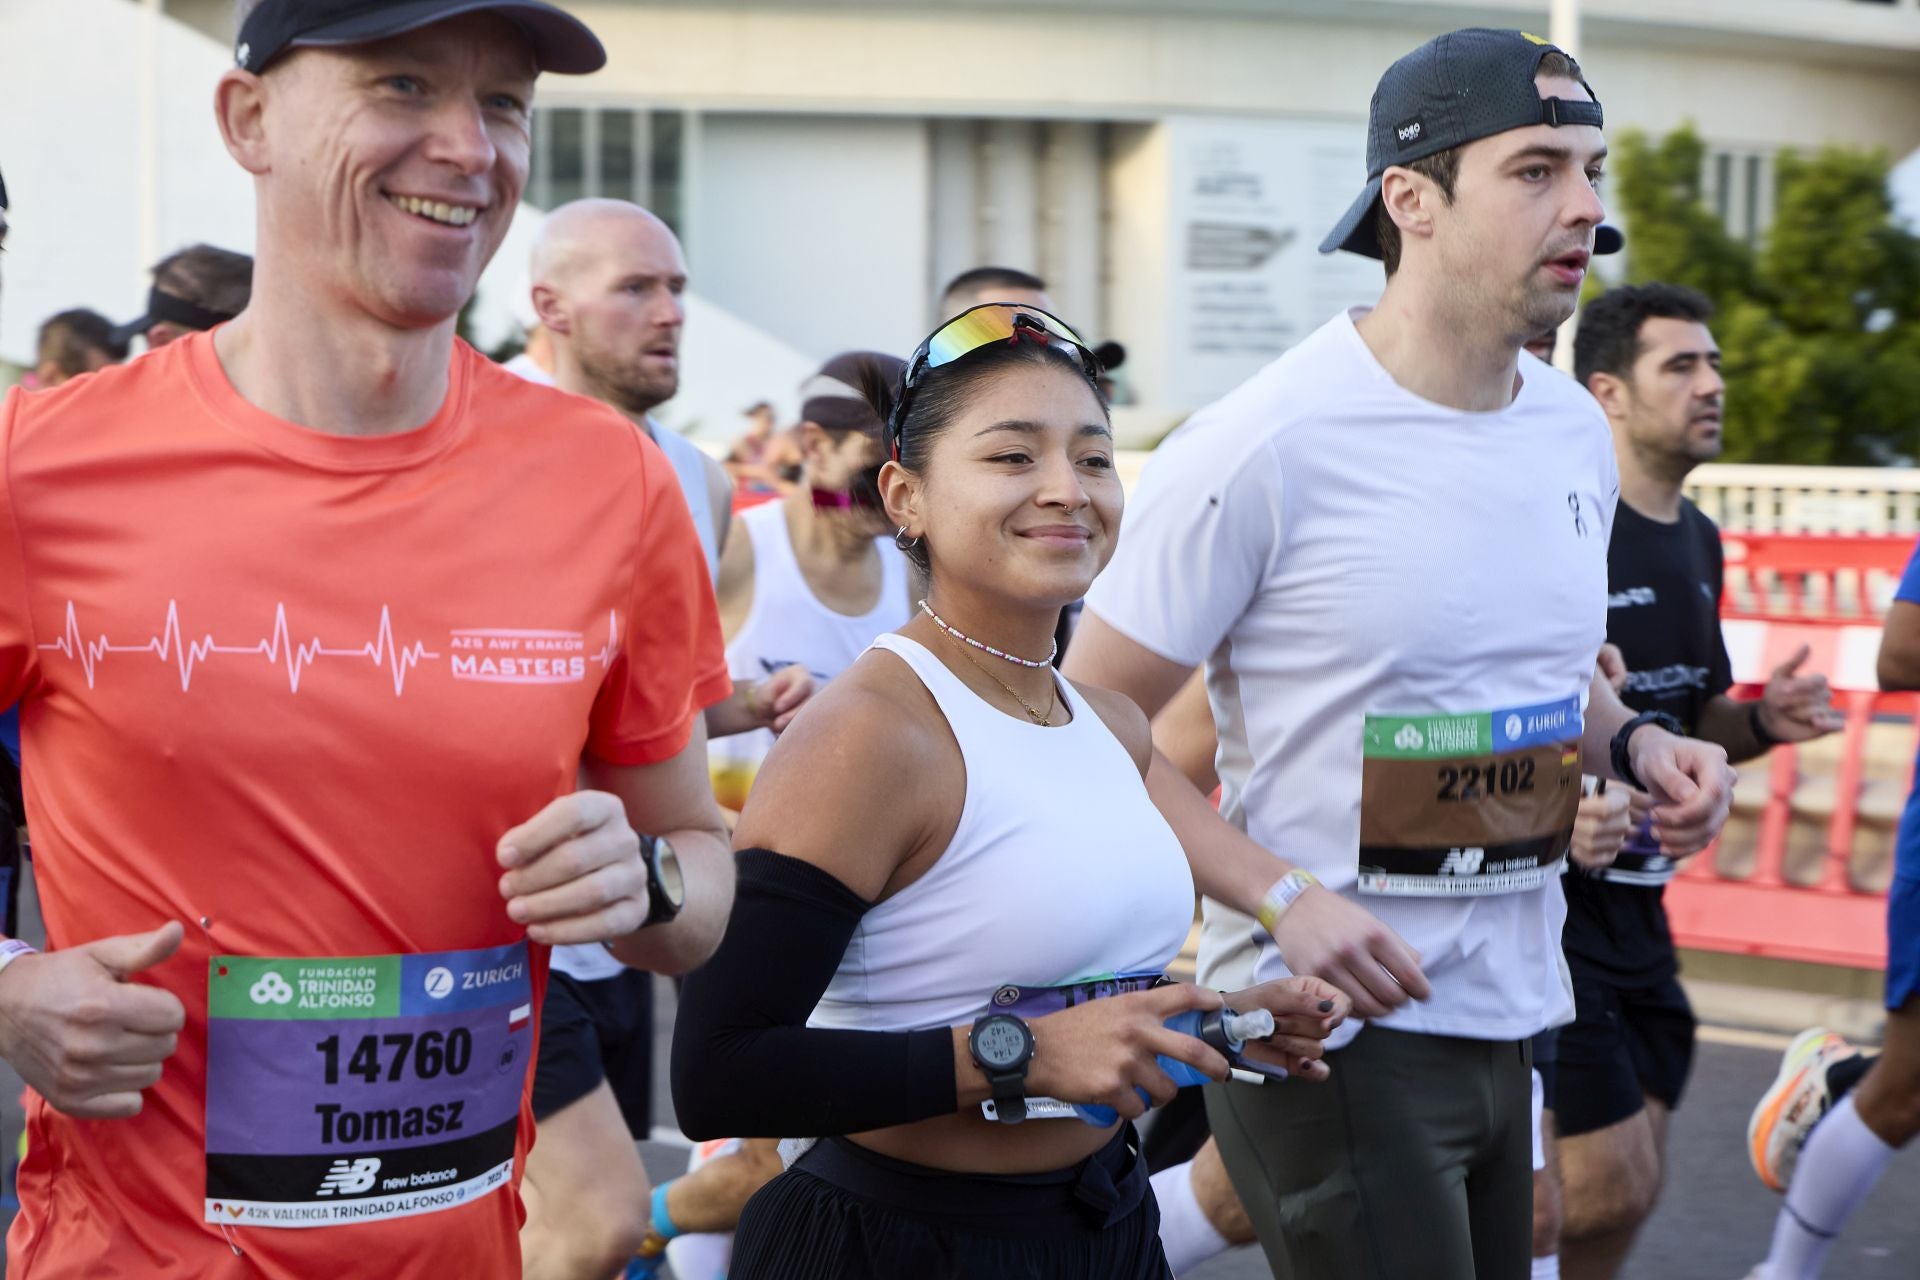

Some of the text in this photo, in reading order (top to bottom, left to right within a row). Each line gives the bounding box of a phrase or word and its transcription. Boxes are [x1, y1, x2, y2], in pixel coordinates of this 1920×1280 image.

[489, 638, 519, 650] AWF
[451, 655, 585, 677] MASTERS
[1436, 756, 1536, 803] 22102
[299, 966, 377, 978] FUNDACIÓN
[461, 962, 523, 990] ZURICH
[298, 979, 376, 994] TRINIDAD
[298, 993, 376, 1009] ALFONSO
[315, 1027, 472, 1084] 14760
[315, 1100, 465, 1144] Tomasz
[382, 1168, 458, 1190] new balance
[273, 1207, 329, 1220] VALENCIA
[332, 1201, 395, 1219] TRINIDAD
[397, 1191, 455, 1211] ALFONSO
